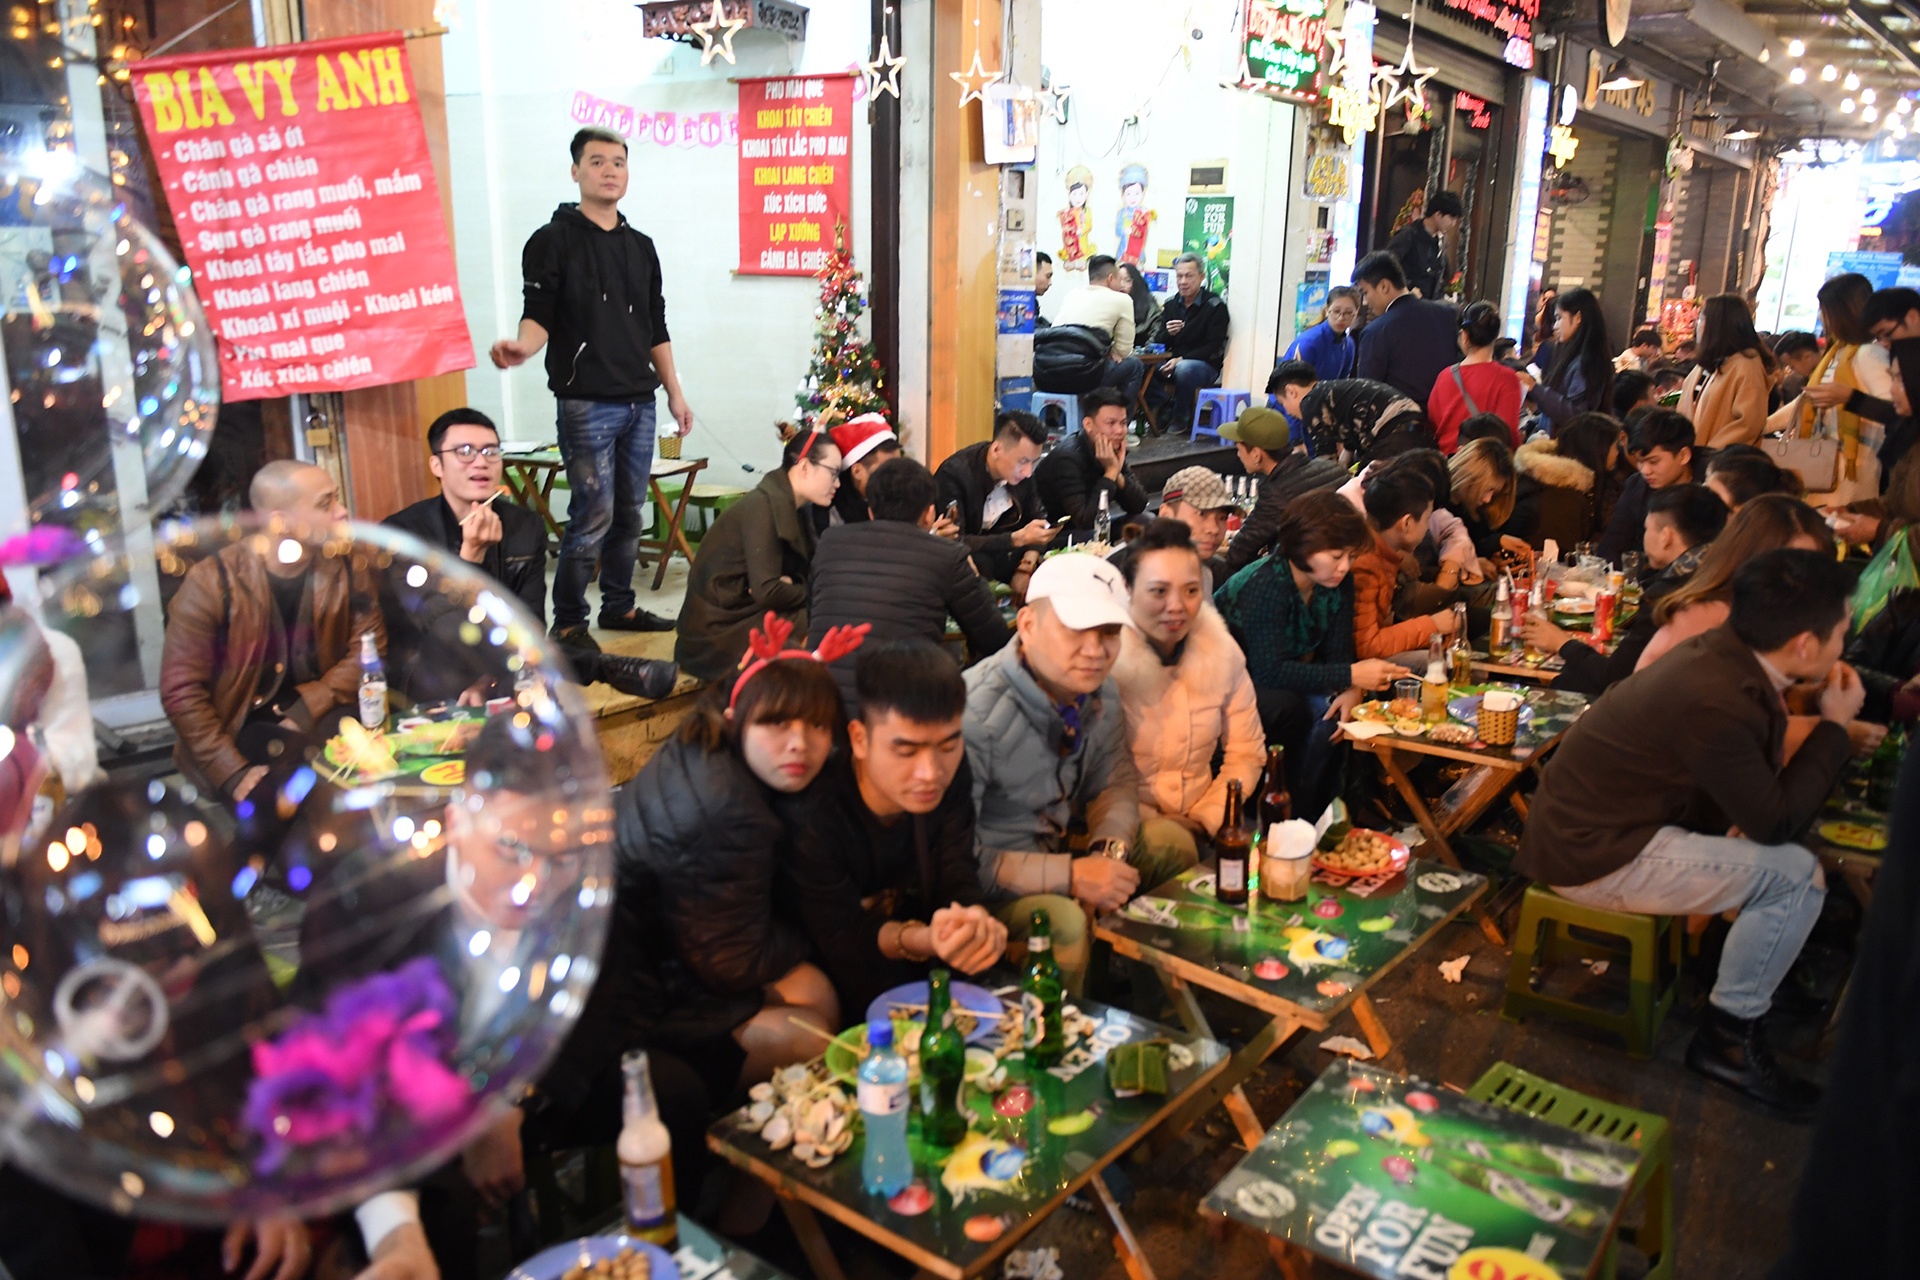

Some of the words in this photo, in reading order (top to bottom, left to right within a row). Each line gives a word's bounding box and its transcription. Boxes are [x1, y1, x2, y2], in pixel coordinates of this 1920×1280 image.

[143, 66, 236, 133] BIA
[233, 57, 299, 121] VY
[316, 46, 410, 112] ANH
[804, 79, 824, 100] QUE
[757, 108, 784, 129] KHOAI
[174, 136, 226, 163] Chân
[229, 133, 255, 158] gà
[742, 138, 770, 158] KHOAI
[182, 167, 234, 193] Cánh
[237, 162, 262, 188] gà
[754, 166, 781, 186] KHOAI
[782, 166, 806, 185] LANG
[190, 198, 242, 222] Chân
[244, 192, 270, 217] gà
[272, 188, 316, 212] rang
[763, 190, 782, 213] XÚC
[1203, 203, 1226, 213] OPEN
[1202, 222, 1226, 234] FUN
[1203, 212, 1226, 223] FOR
[198, 230, 238, 254] Sụn
[240, 223, 266, 248] gà
[268, 218, 312, 240] rang
[205, 253, 263, 281] Khoai
[265, 249, 294, 273] tây
[369, 231, 406, 256] mai
[760, 247, 785, 269] CÁNH
[213, 282, 270, 311] Khoai
[272, 278, 316, 299] lang
[220, 311, 277, 339] Khoai
[364, 288, 418, 316] Khoai
[270, 336, 307, 359] mai
[310, 332, 345, 356] que
[1315, 1182, 1381, 1247] OPEN
[1352, 1199, 1429, 1270] FOR
[1396, 1213, 1475, 1280] FUN
